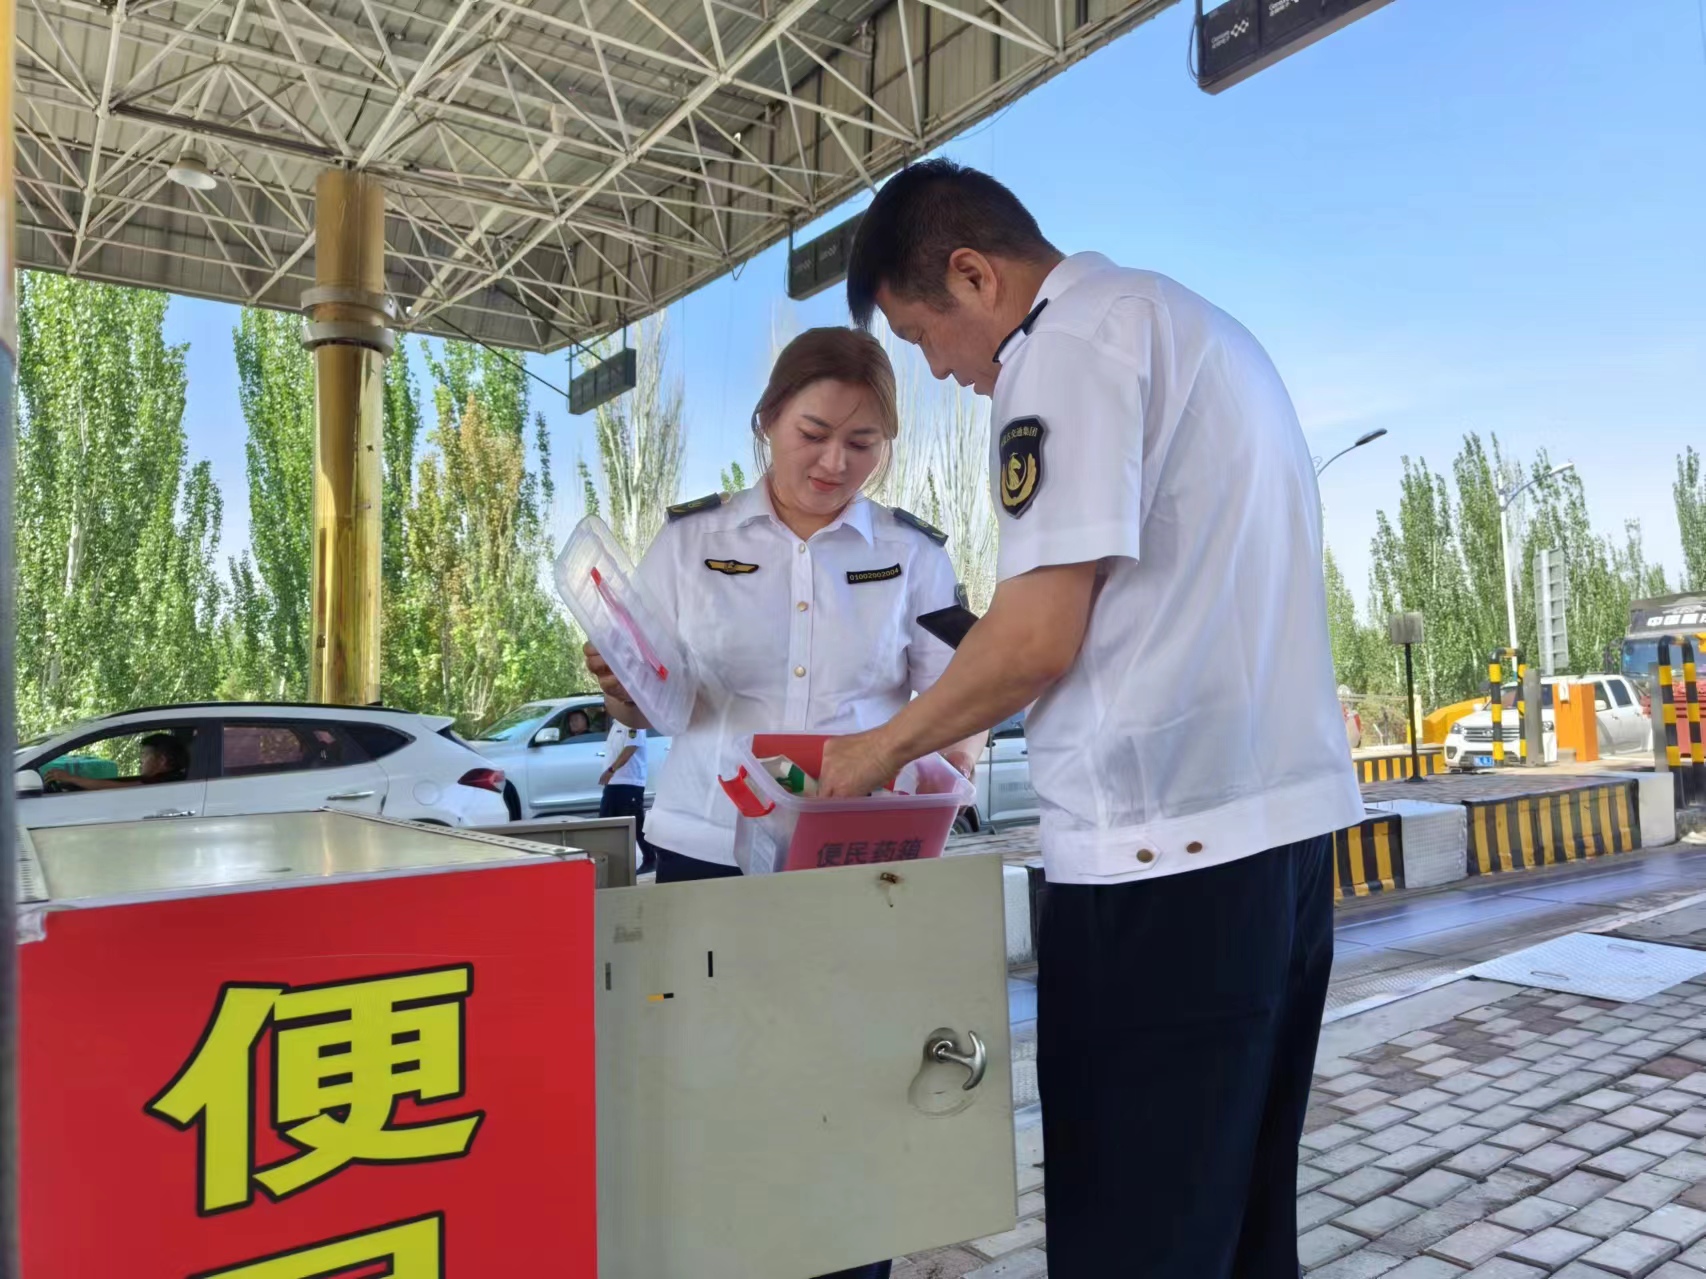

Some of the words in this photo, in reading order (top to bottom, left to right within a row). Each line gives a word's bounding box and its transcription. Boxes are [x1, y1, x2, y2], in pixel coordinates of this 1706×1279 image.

[816, 837, 924, 868] 便民药箱
[143, 961, 486, 1279] 便
